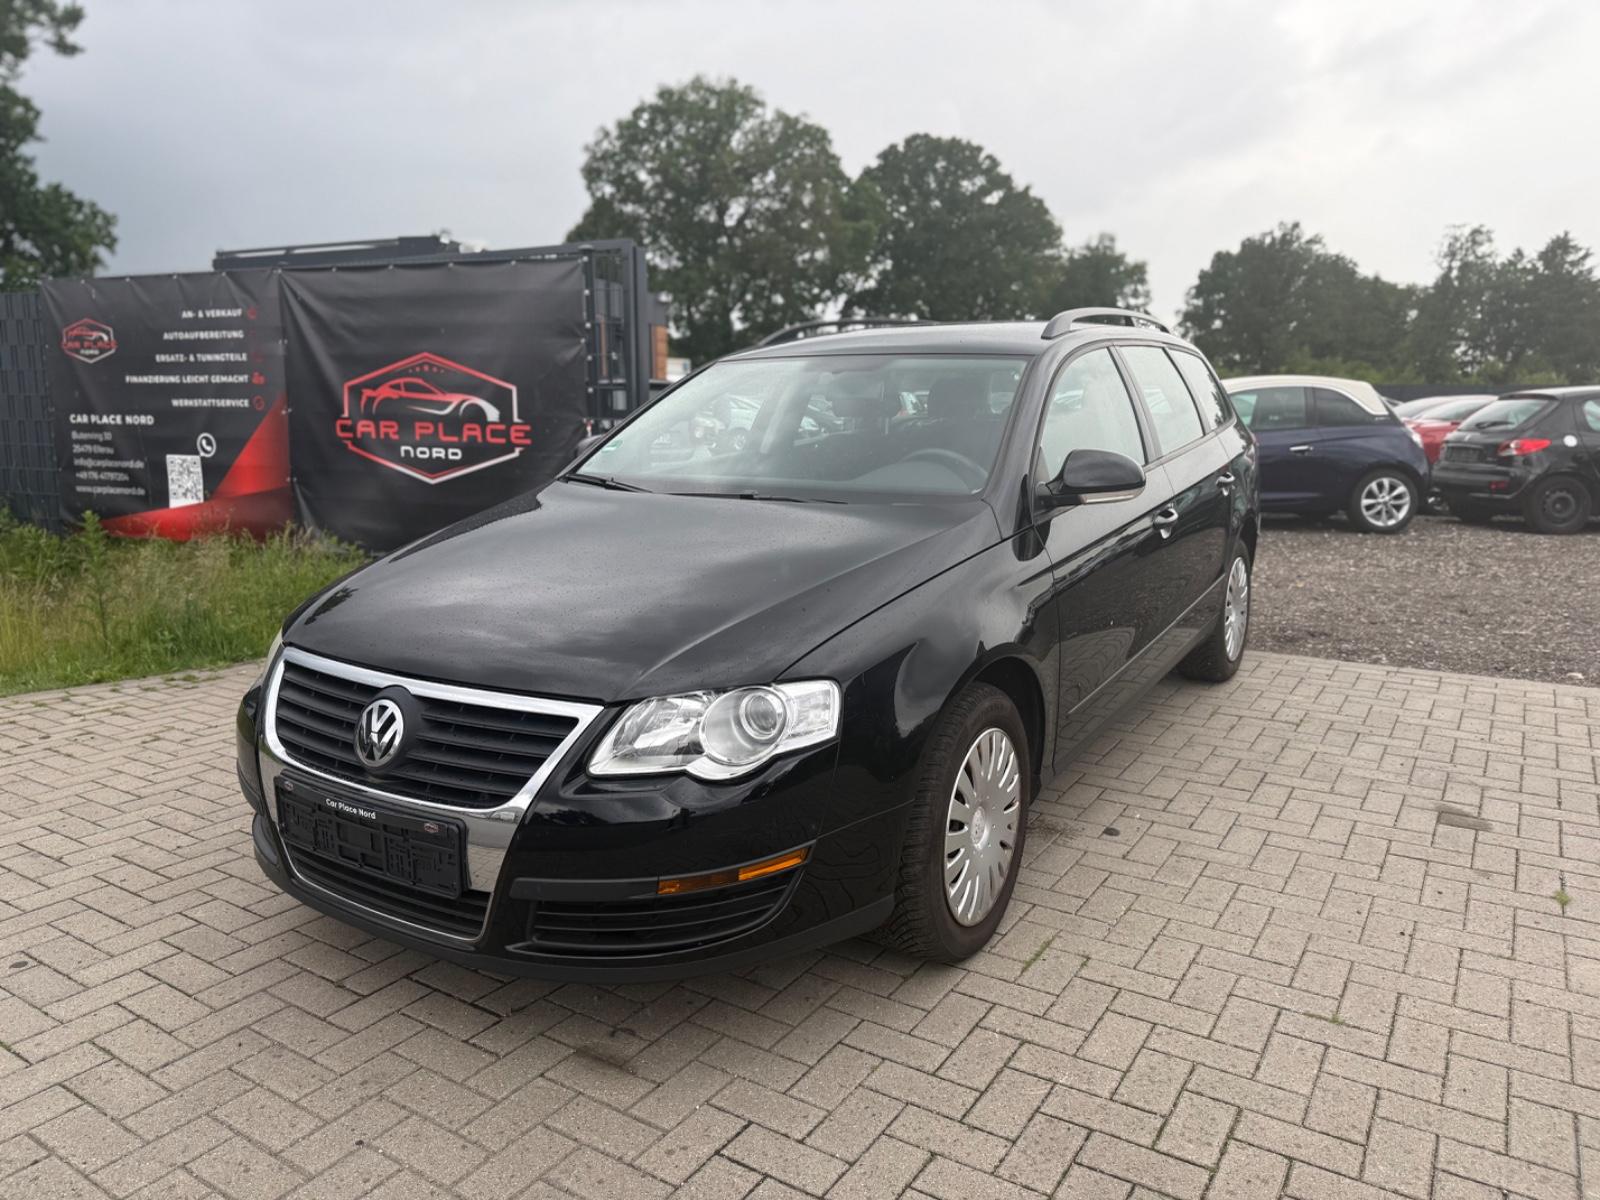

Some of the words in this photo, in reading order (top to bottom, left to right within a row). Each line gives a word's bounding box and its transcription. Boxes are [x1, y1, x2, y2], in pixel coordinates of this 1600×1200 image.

[205, 308, 243, 318] VERKAUF
[162, 329, 245, 341] AUTOAUFBEREITUNG
[189, 354, 195, 362] &
[196, 353, 248, 362] TUNINGTEILE
[125, 374, 181, 384] FINANZIERUNG
[182, 374, 209, 384] LEICHT
[210, 374, 249, 384] GEMACHT
[171, 398, 250, 408] WERKSTATTSERVICE
[69, 413, 89, 424] CAR
[90, 414, 122, 425] PLACE
[125, 415, 155, 425] NORD
[335, 418, 400, 440] CAR
[414, 421, 532, 445] PLACE
[400, 445, 463, 460] NORD
[325, 797, 338, 808] Car
[338, 801, 357, 814] Place
[358, 807, 376, 820] Nord
